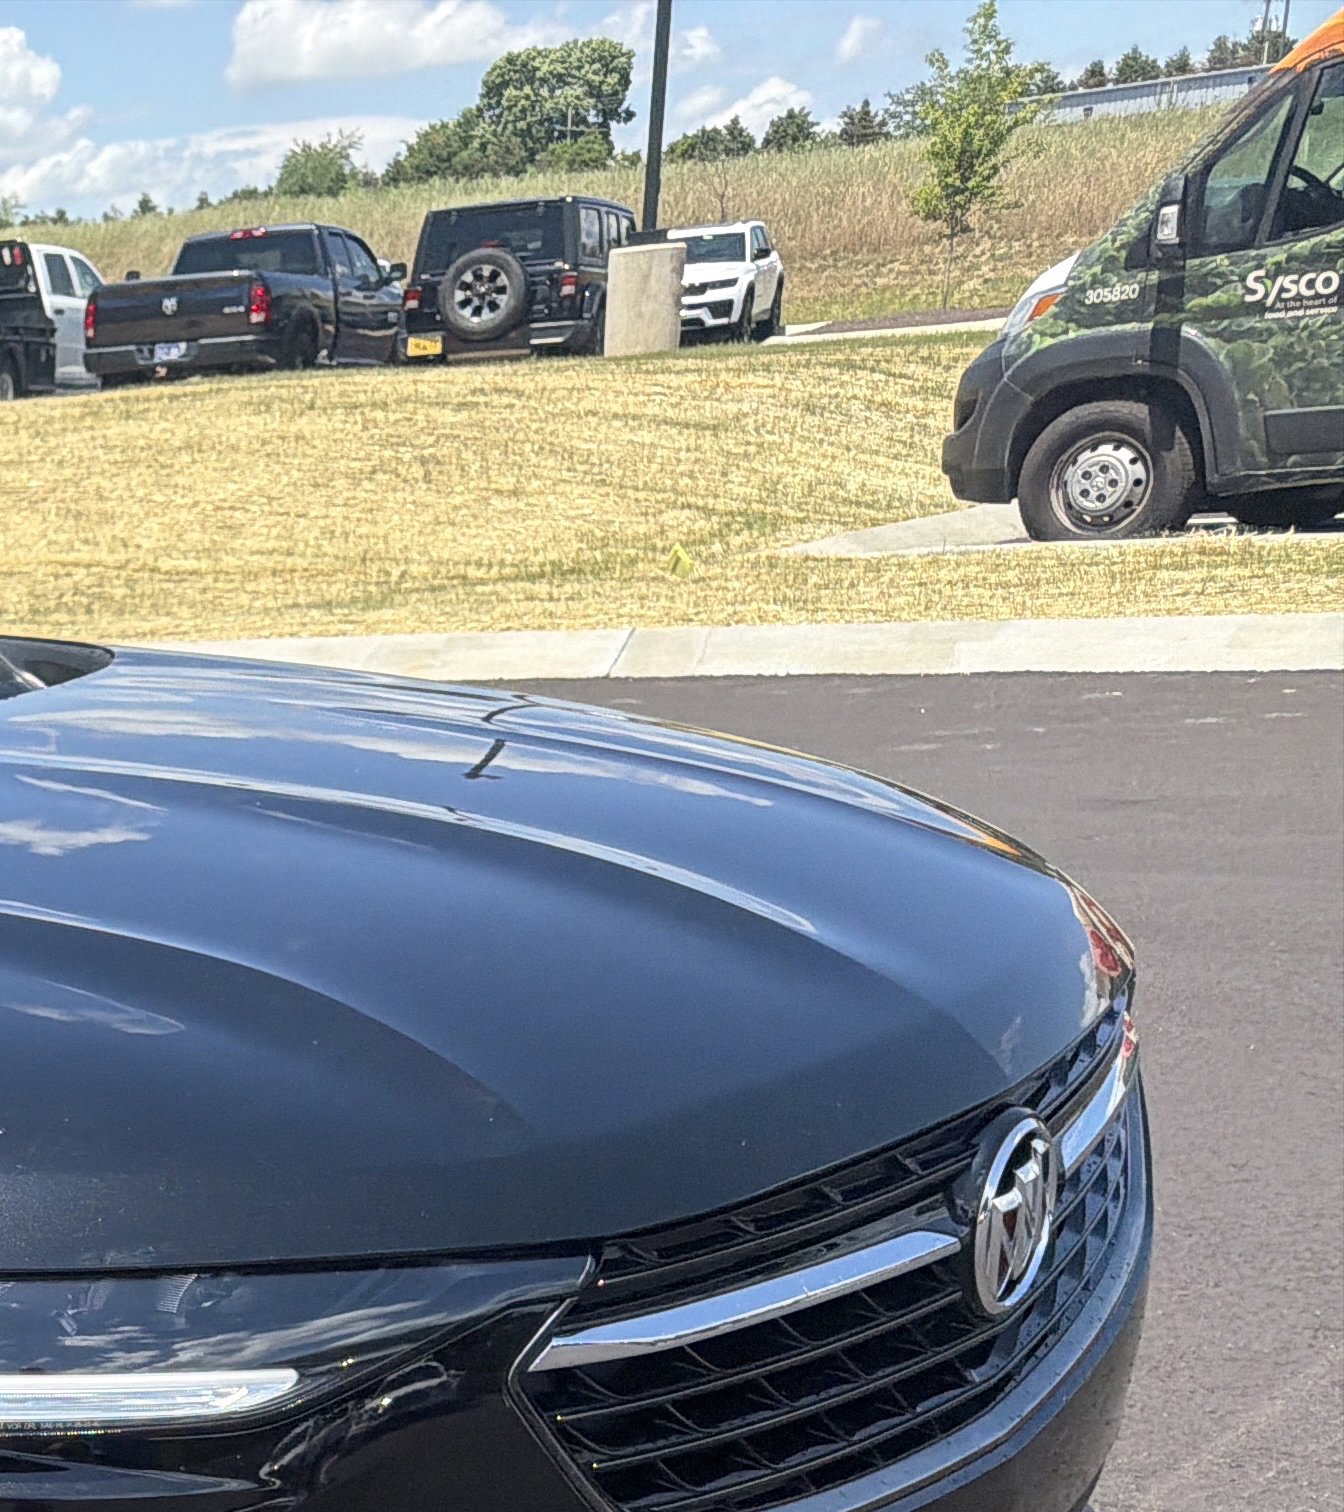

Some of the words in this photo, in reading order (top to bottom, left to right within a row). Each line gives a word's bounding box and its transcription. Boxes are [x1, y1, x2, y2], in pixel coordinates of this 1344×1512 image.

[1085, 283, 1140, 305] 305820
[1286, 299, 1302, 309] the
[1302, 297, 1327, 307] heart
[1327, 295, 1338, 304] of
[1264, 309, 1286, 320] food
[1286, 307, 1305, 318] and
[1305, 306, 1339, 316] service
